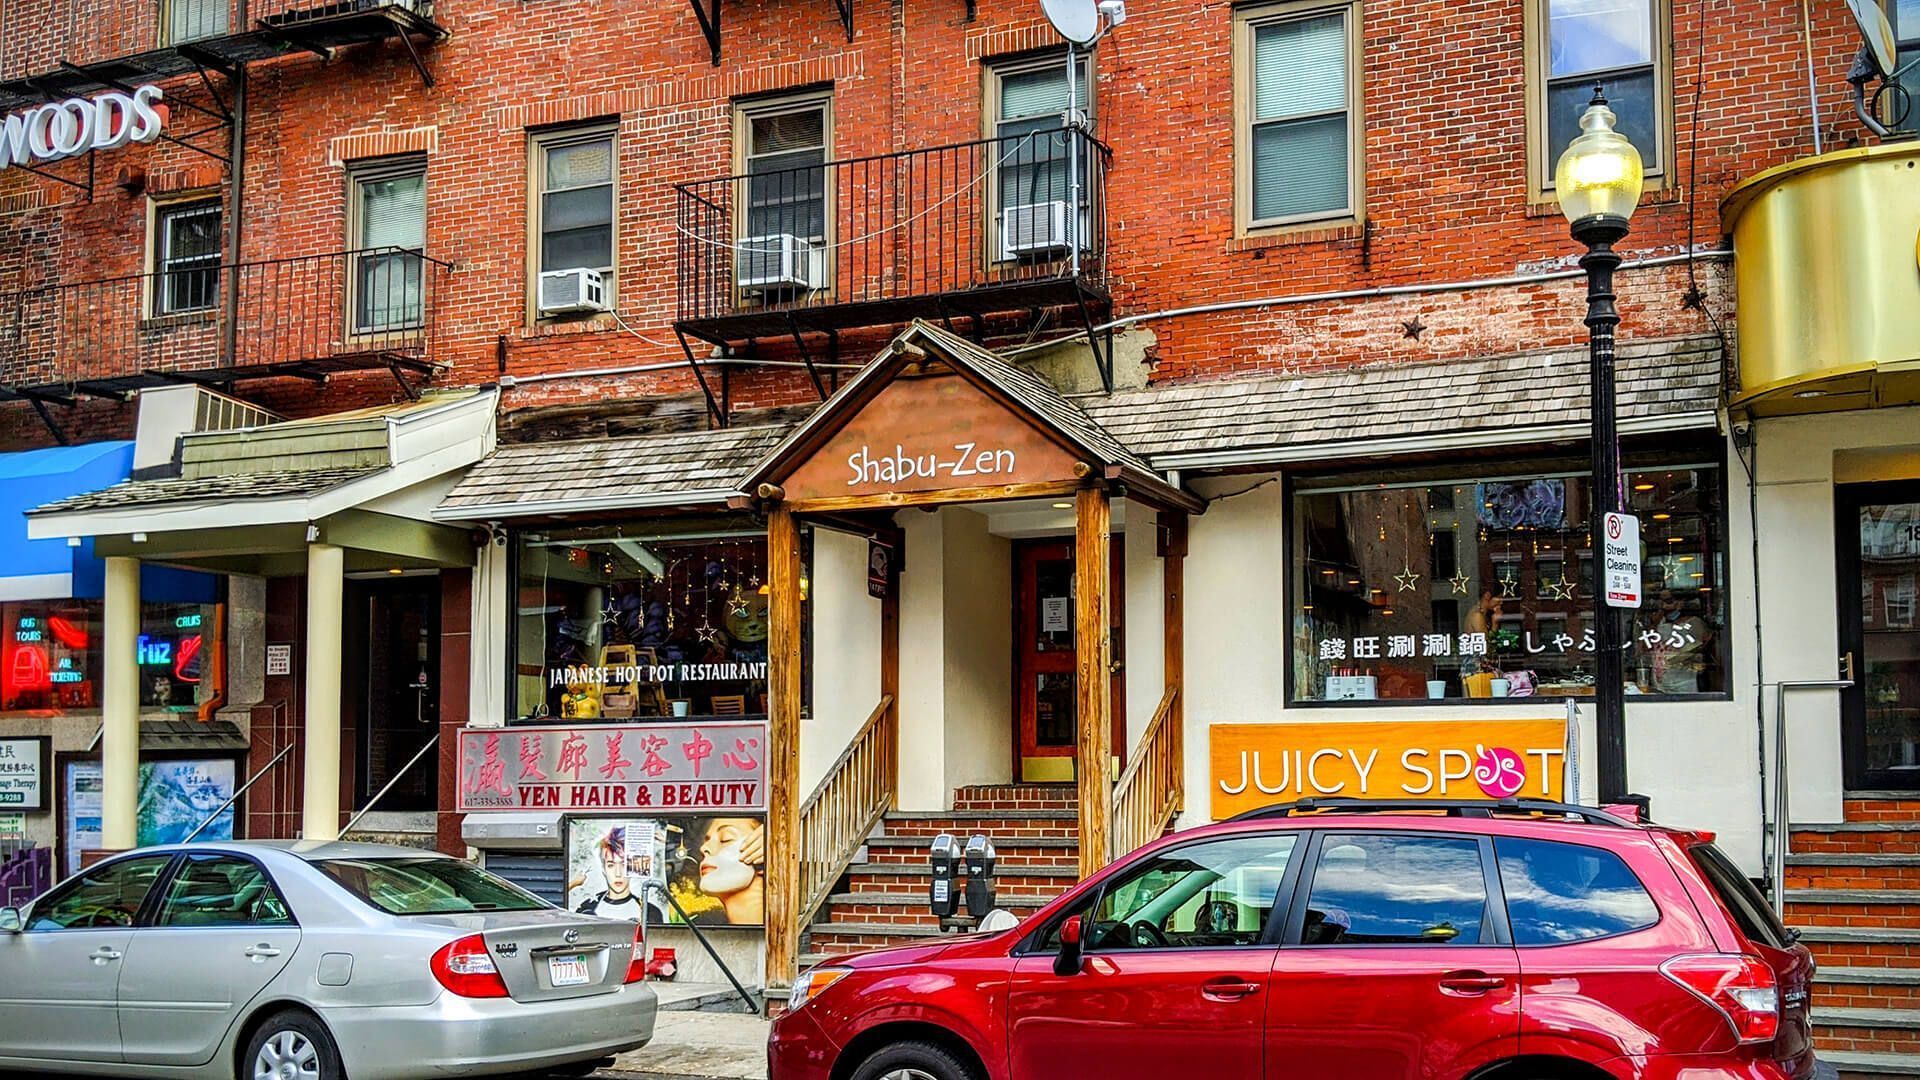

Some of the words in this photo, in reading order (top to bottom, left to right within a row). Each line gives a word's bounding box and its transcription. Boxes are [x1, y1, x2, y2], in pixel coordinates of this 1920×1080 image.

[847, 442, 1015, 486] Shabu-Zen
[1606, 543, 1628, 557] Street
[1606, 558, 1637, 574] Cleaning
[16, 631, 42, 641] TOURS
[1320, 632, 1487, 660] 錢旺涮涮鍋
[550, 666, 609, 689] JAPANESE
[615, 665, 643, 683] HOT
[649, 664, 675, 682] POT
[681, 662, 767, 682] RESTAURANT
[1219, 748, 1379, 794] JUICY
[13, 778, 37, 791] Therapy
[518, 785, 561, 807] YEN
[570, 784, 626, 807] HAIR
[636, 785, 653, 806] &
[662, 783, 758, 806] BEAUTY
